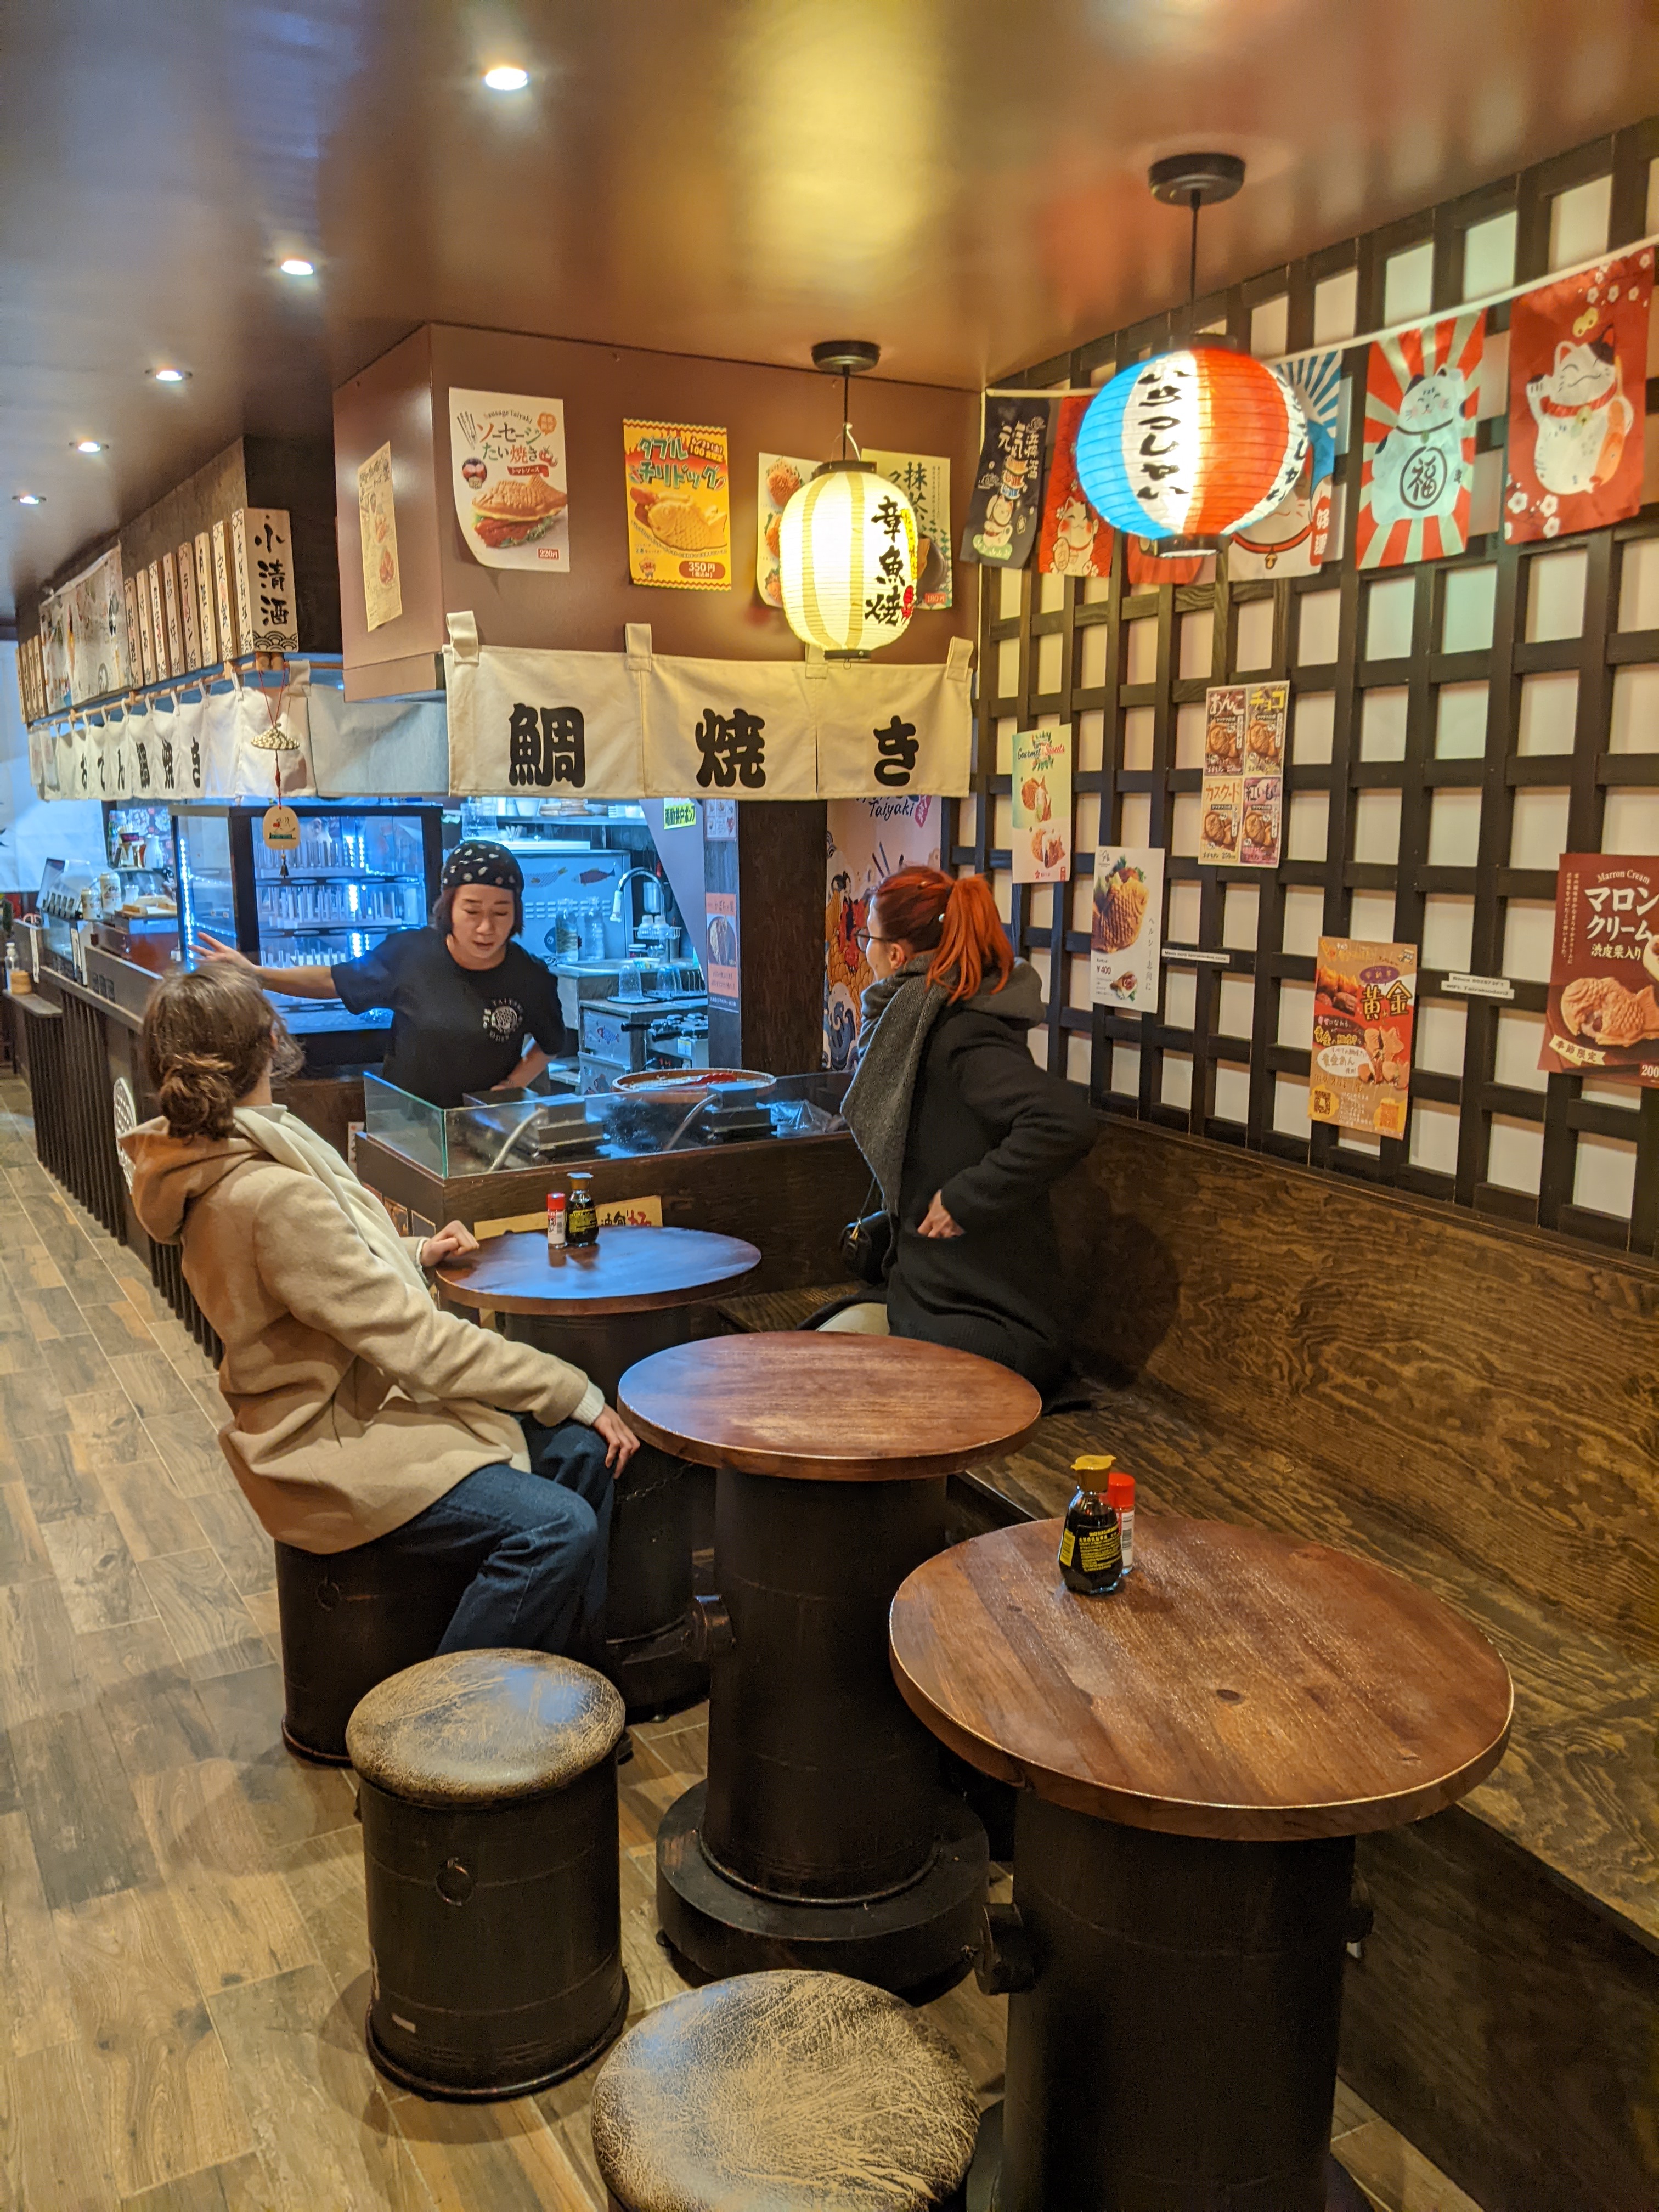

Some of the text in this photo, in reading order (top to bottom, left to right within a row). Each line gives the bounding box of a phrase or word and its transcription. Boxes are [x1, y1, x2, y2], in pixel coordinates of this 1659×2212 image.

[477, 422, 541, 445] ソーセージ
[482, 442, 537, 464] たい焼き
[639, 436, 689, 460] ダブル
[639, 460, 721, 489] チリドッグ
[1407, 453, 1437, 501] 福
[904, 461, 928, 521] 抹茶
[539, 549, 558, 558] 220円
[689, 562, 715, 573] 350円
[927, 594, 945, 603] 180円
[1210, 693, 1244, 716] あんこ
[1250, 690, 1285, 712] チョコ
[1017, 743, 1065, 761] Gourmet Sweets
[1206, 783, 1240, 803] カスタード
[868, 799, 915, 821] Taiyaki
[1596, 869, 1650, 884] Marron Cream
[1584, 887, 1659, 916] マロン
[1587, 915, 1652, 941] クリーム
[1591, 943, 1641, 961] 渋皮栗入り
[1555, 1039, 1598, 1063] 季節限定
